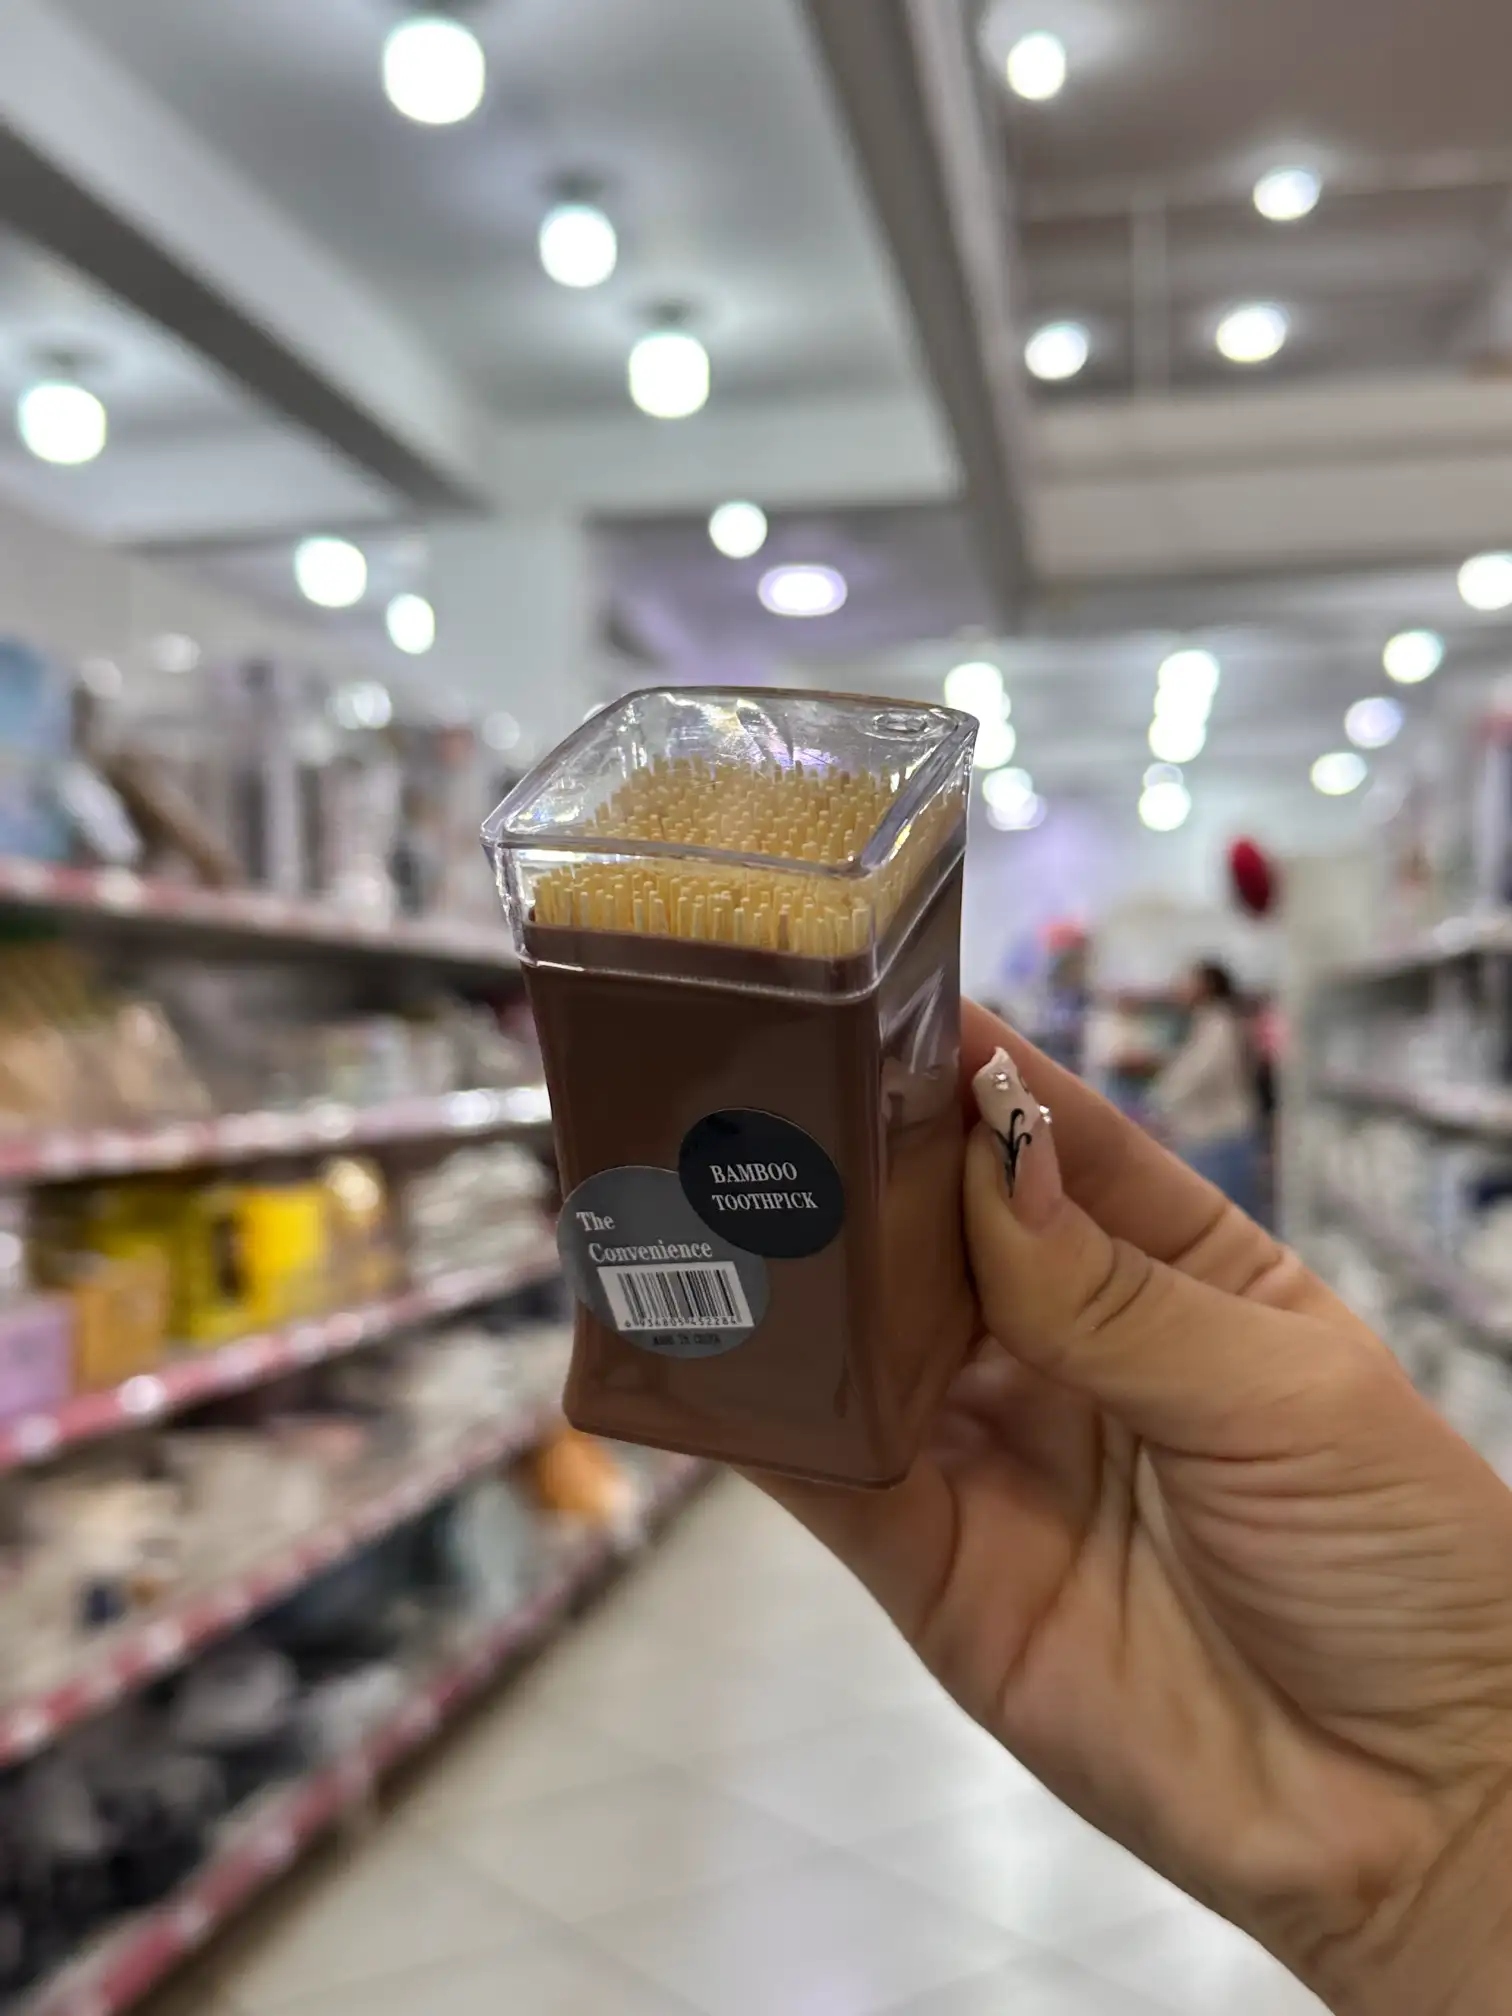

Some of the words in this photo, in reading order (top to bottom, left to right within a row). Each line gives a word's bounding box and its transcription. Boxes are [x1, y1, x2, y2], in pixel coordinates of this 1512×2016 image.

[709, 1162, 798, 1183] BAMBOO
[711, 1191, 819, 1211] TOOTHPICK
[576, 1211, 616, 1232] The
[588, 1239, 713, 1263] Convenience
